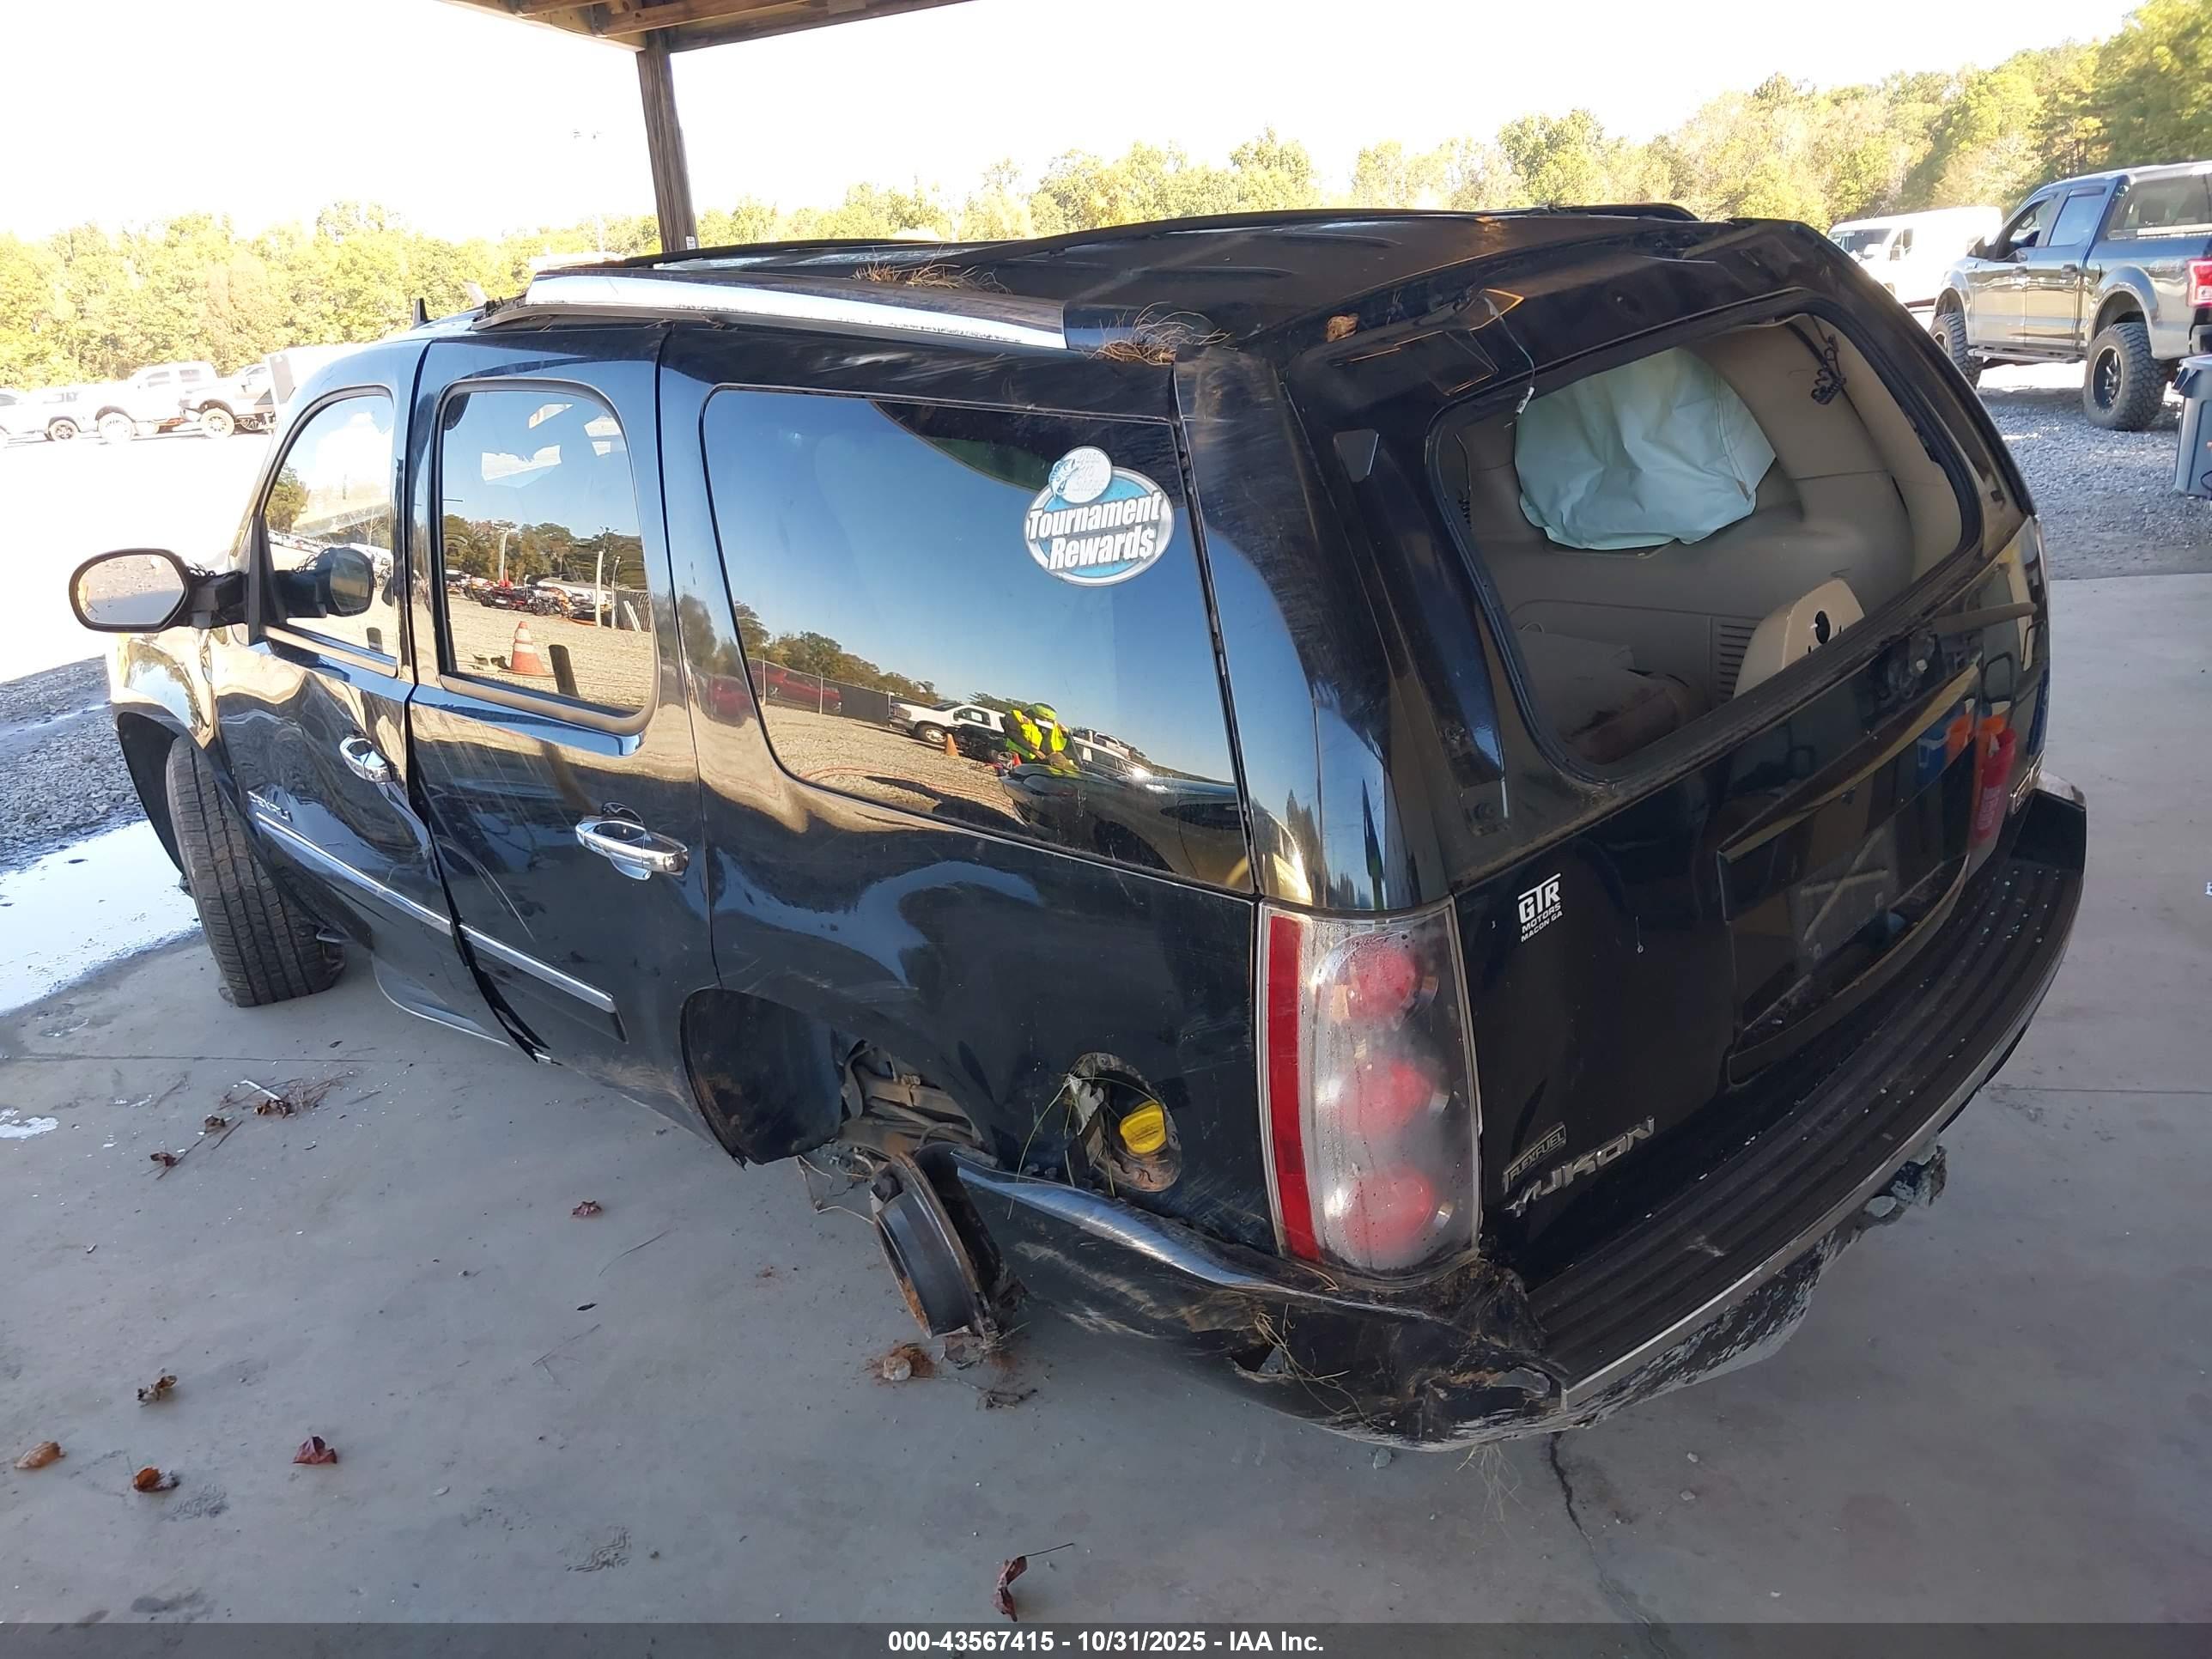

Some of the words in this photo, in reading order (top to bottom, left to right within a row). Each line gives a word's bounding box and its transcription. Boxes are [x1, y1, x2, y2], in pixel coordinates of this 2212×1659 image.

[1028, 491, 1163, 540] Tournament
[1517, 872, 1562, 924] GTR
[1522, 902, 1562, 934] MOTORS
[1521, 918, 1550, 943] MACON
[1551, 910, 1564, 922] GA
